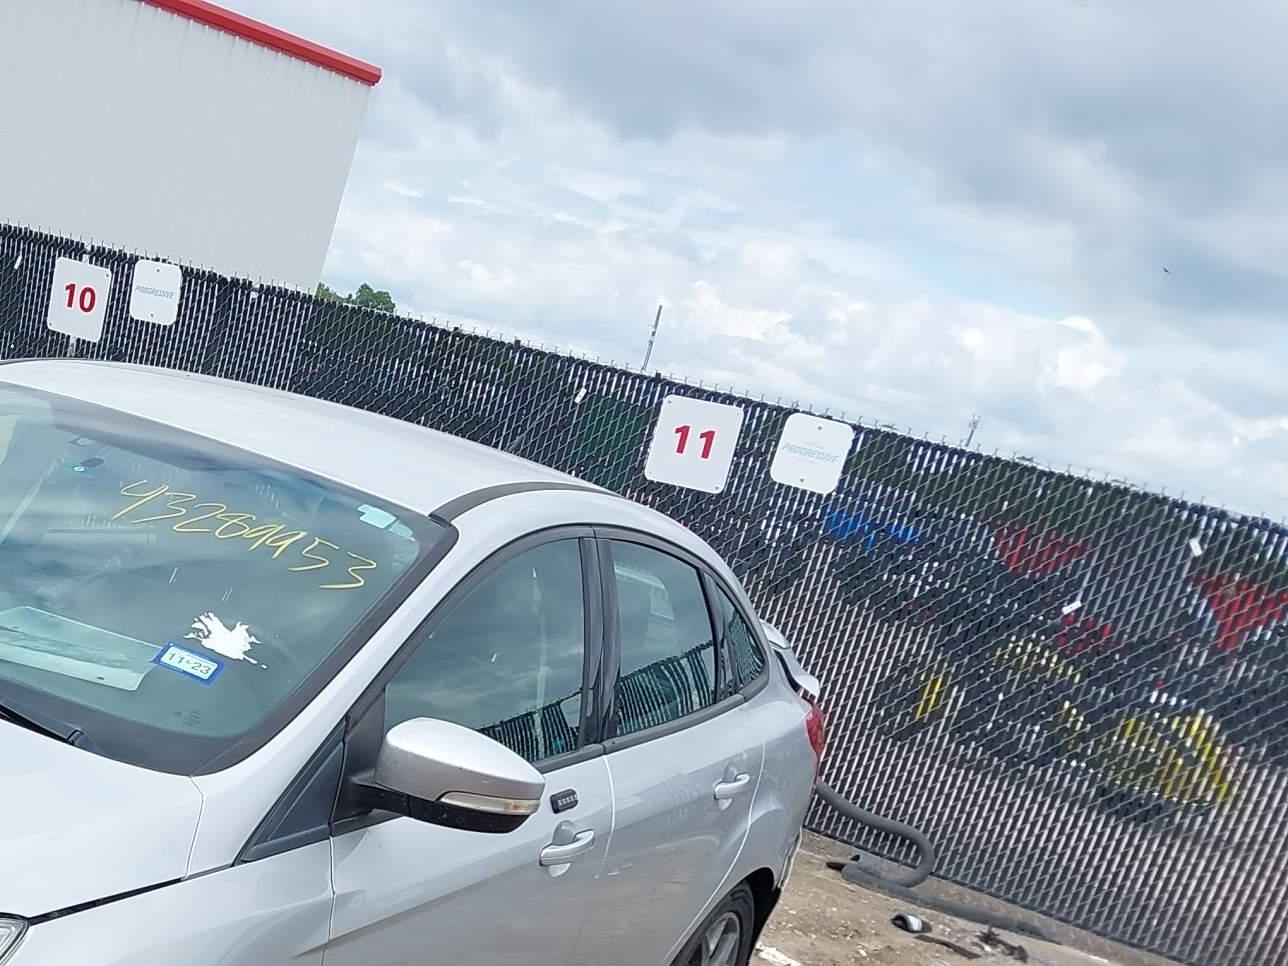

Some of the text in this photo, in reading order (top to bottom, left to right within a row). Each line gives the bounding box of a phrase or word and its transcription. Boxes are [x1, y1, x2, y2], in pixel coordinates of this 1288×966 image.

[64, 282, 97, 314] 10
[673, 424, 717, 460] 11
[111, 479, 378, 589] 43289953
